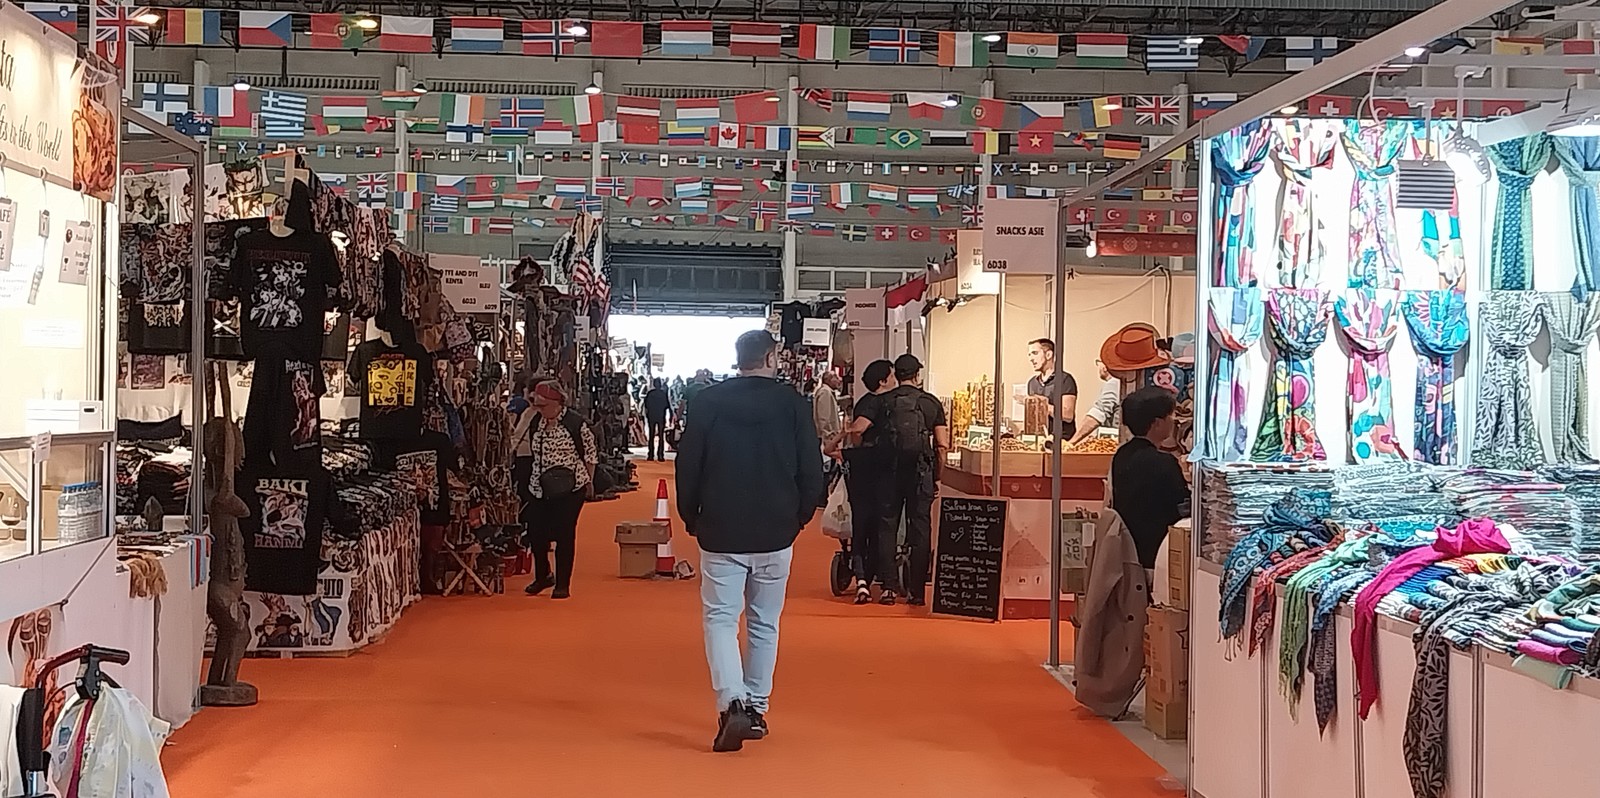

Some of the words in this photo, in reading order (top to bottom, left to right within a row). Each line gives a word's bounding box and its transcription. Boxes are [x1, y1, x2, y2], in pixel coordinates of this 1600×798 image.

[19, 115, 32, 150] the
[37, 121, 62, 161] World
[996, 226, 1026, 236] SNACKS
[1028, 227, 1045, 236] ASIE
[987, 260, 1007, 269] 6D38
[258, 478, 309, 497] BAKI
